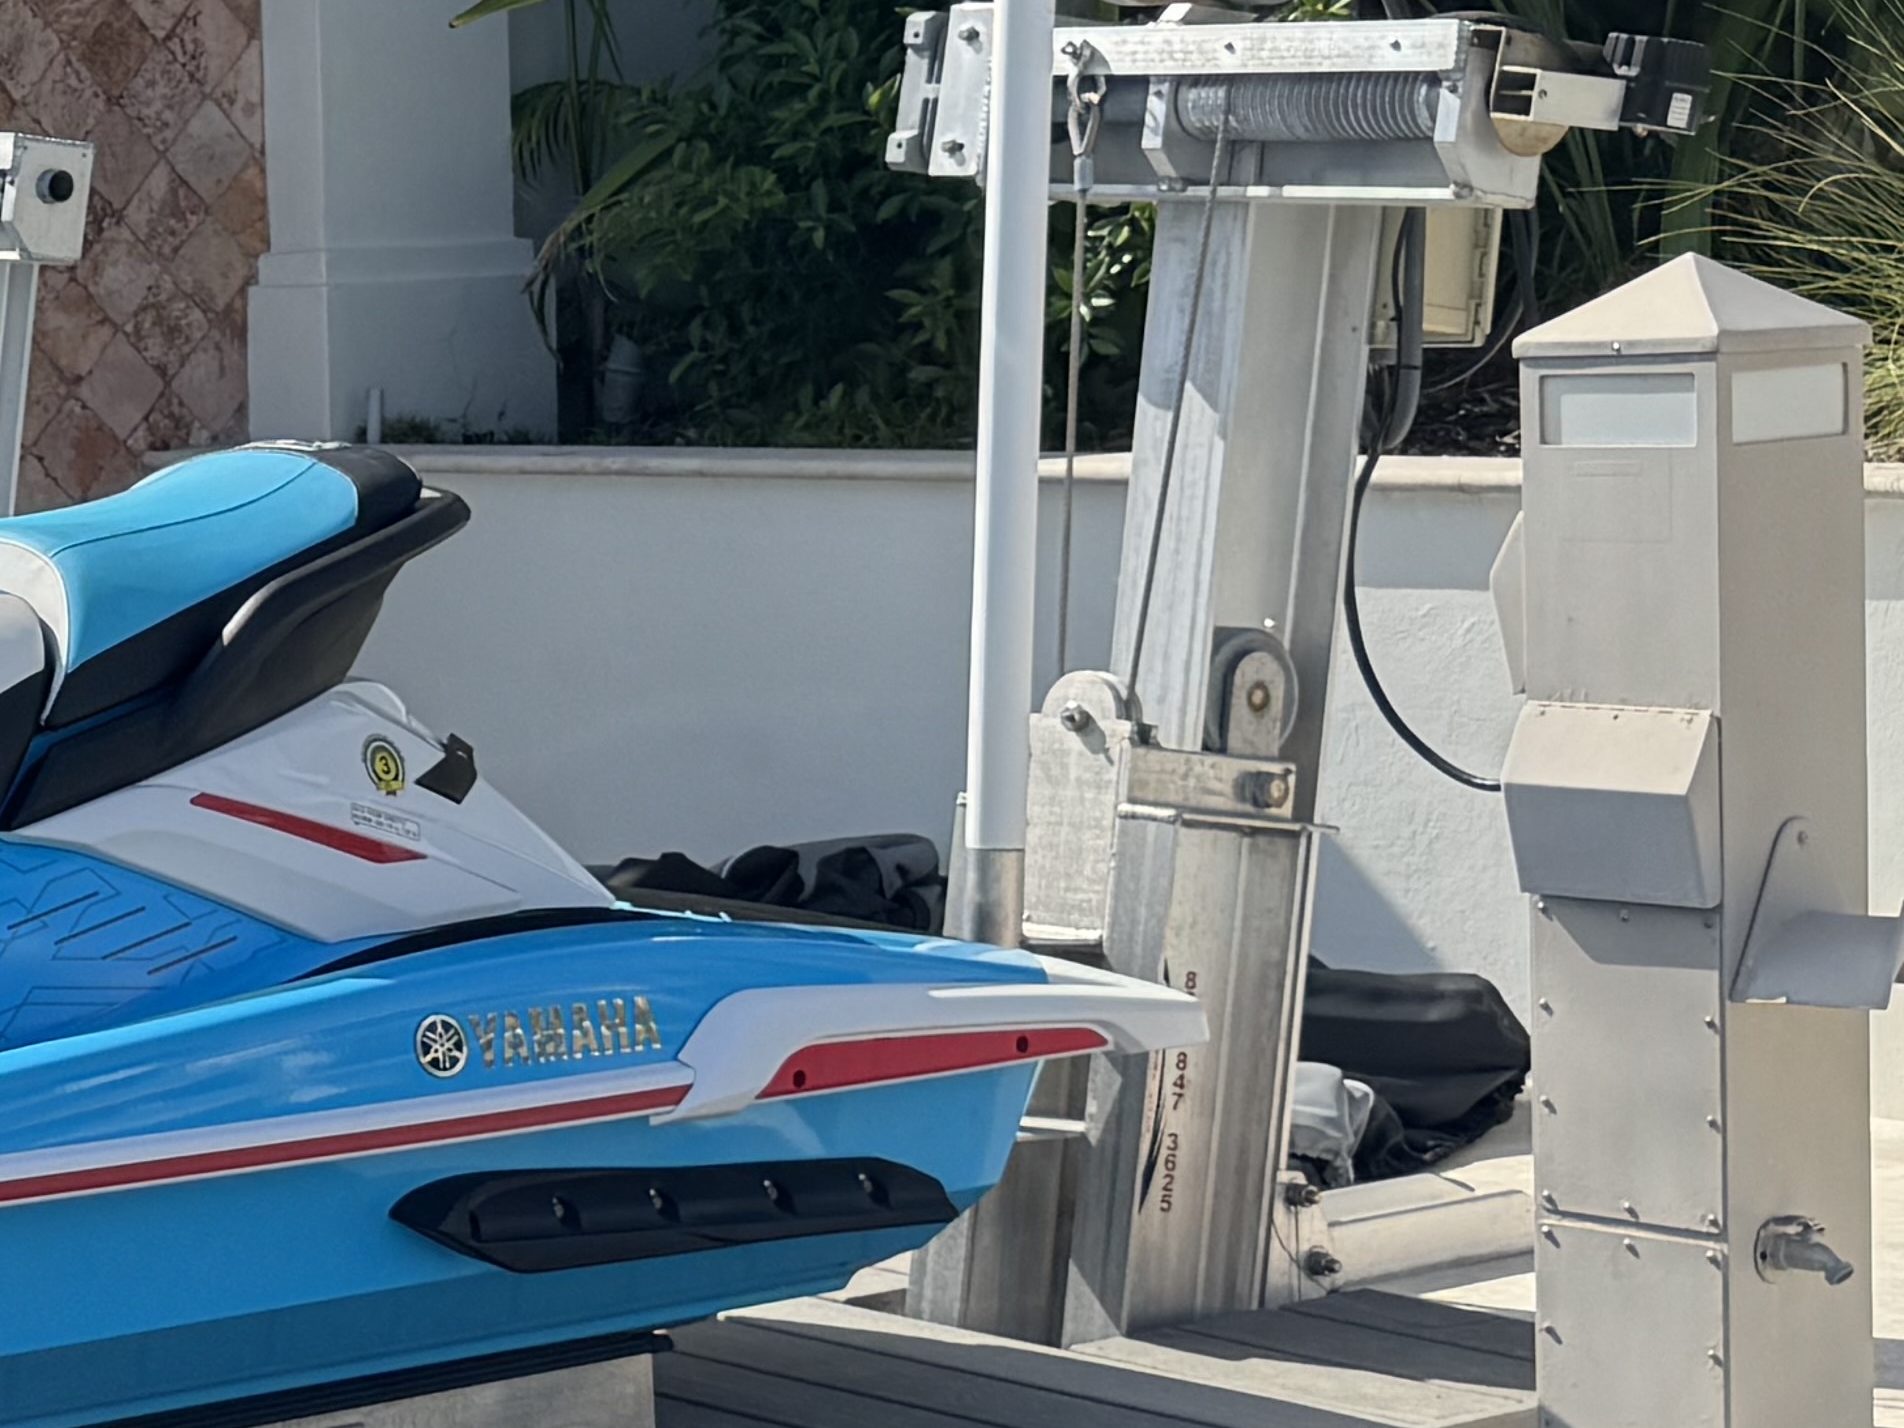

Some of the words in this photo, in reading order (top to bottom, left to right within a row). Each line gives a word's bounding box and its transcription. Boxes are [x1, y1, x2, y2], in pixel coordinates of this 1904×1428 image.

[379, 755, 391, 775] 3
[468, 995, 662, 1068] YAMAHA
[1172, 1051, 1188, 1110] 847
[1159, 1132, 1179, 1213] 3625
